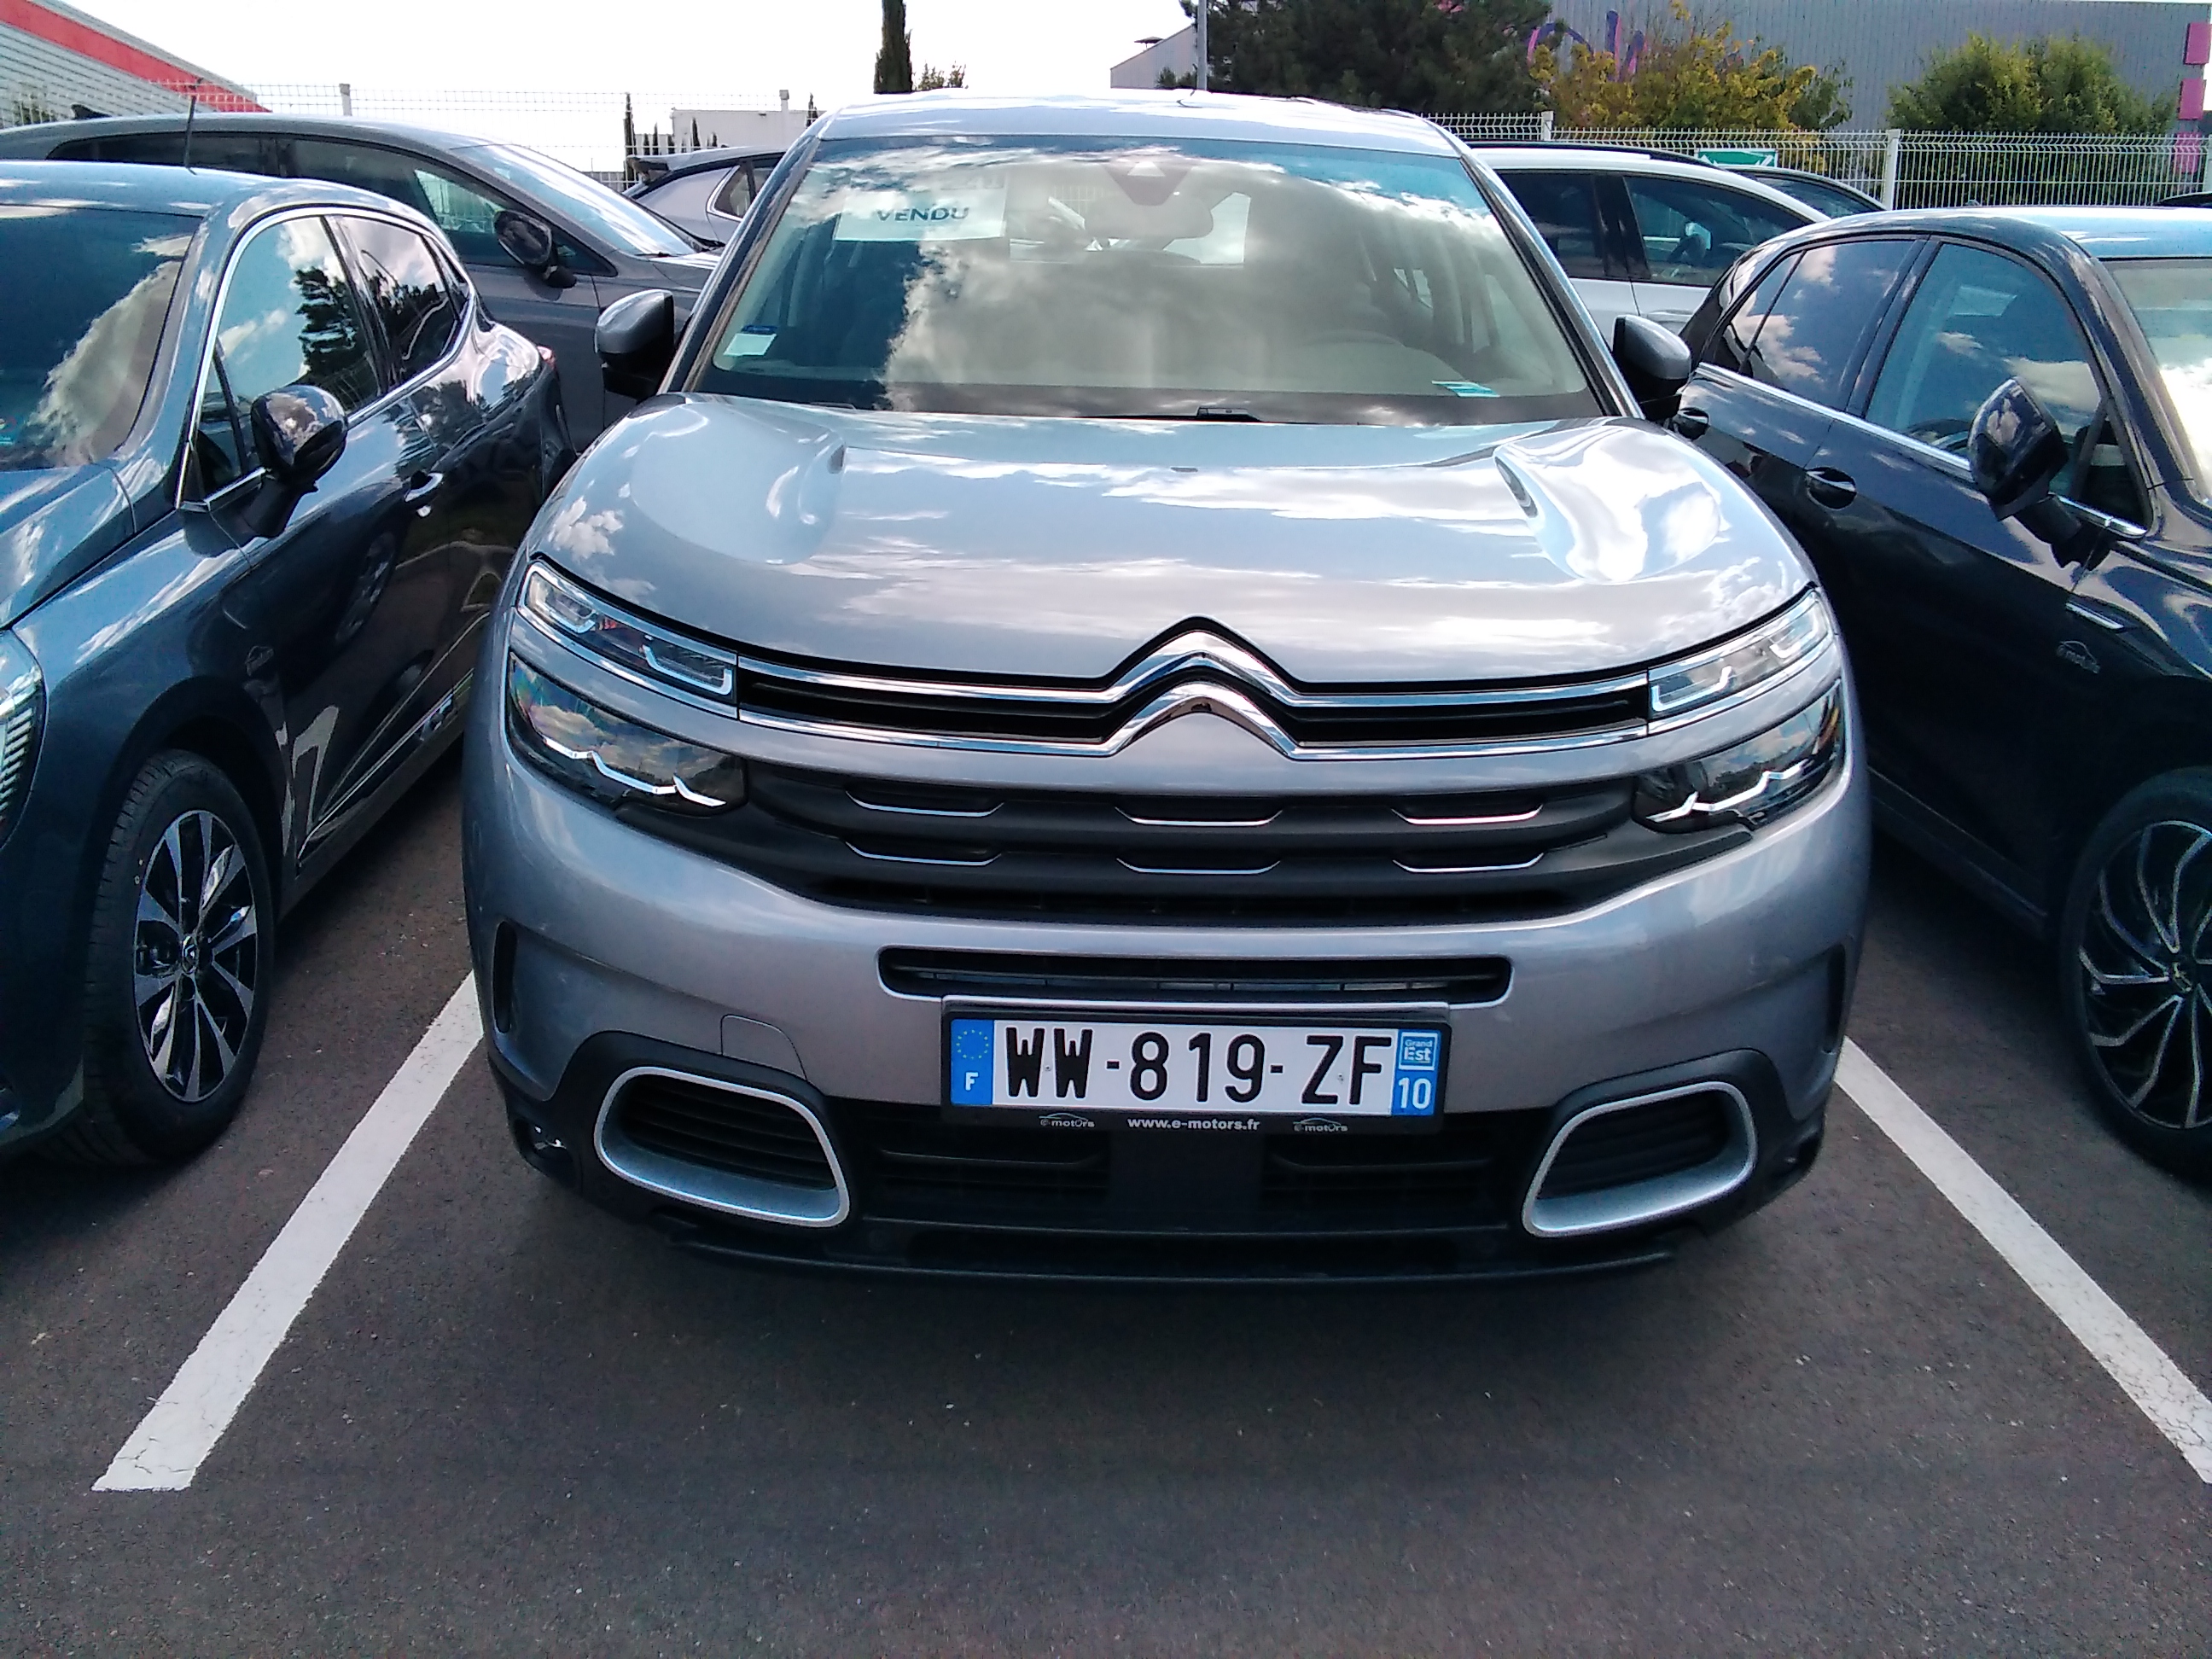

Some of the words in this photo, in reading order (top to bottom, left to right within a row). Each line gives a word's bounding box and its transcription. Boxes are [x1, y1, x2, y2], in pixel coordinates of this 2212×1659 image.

[876, 207, 969, 222] VENDU
[1405, 1039, 1433, 1047] Grand
[1403, 1046, 1432, 1061] Est
[1005, 1027, 1393, 1106] WW-819-ZF
[965, 1072, 979, 1091] F
[1398, 1077, 1432, 1109] 10
[1127, 1118, 1260, 1131] www.e-motors.fr
